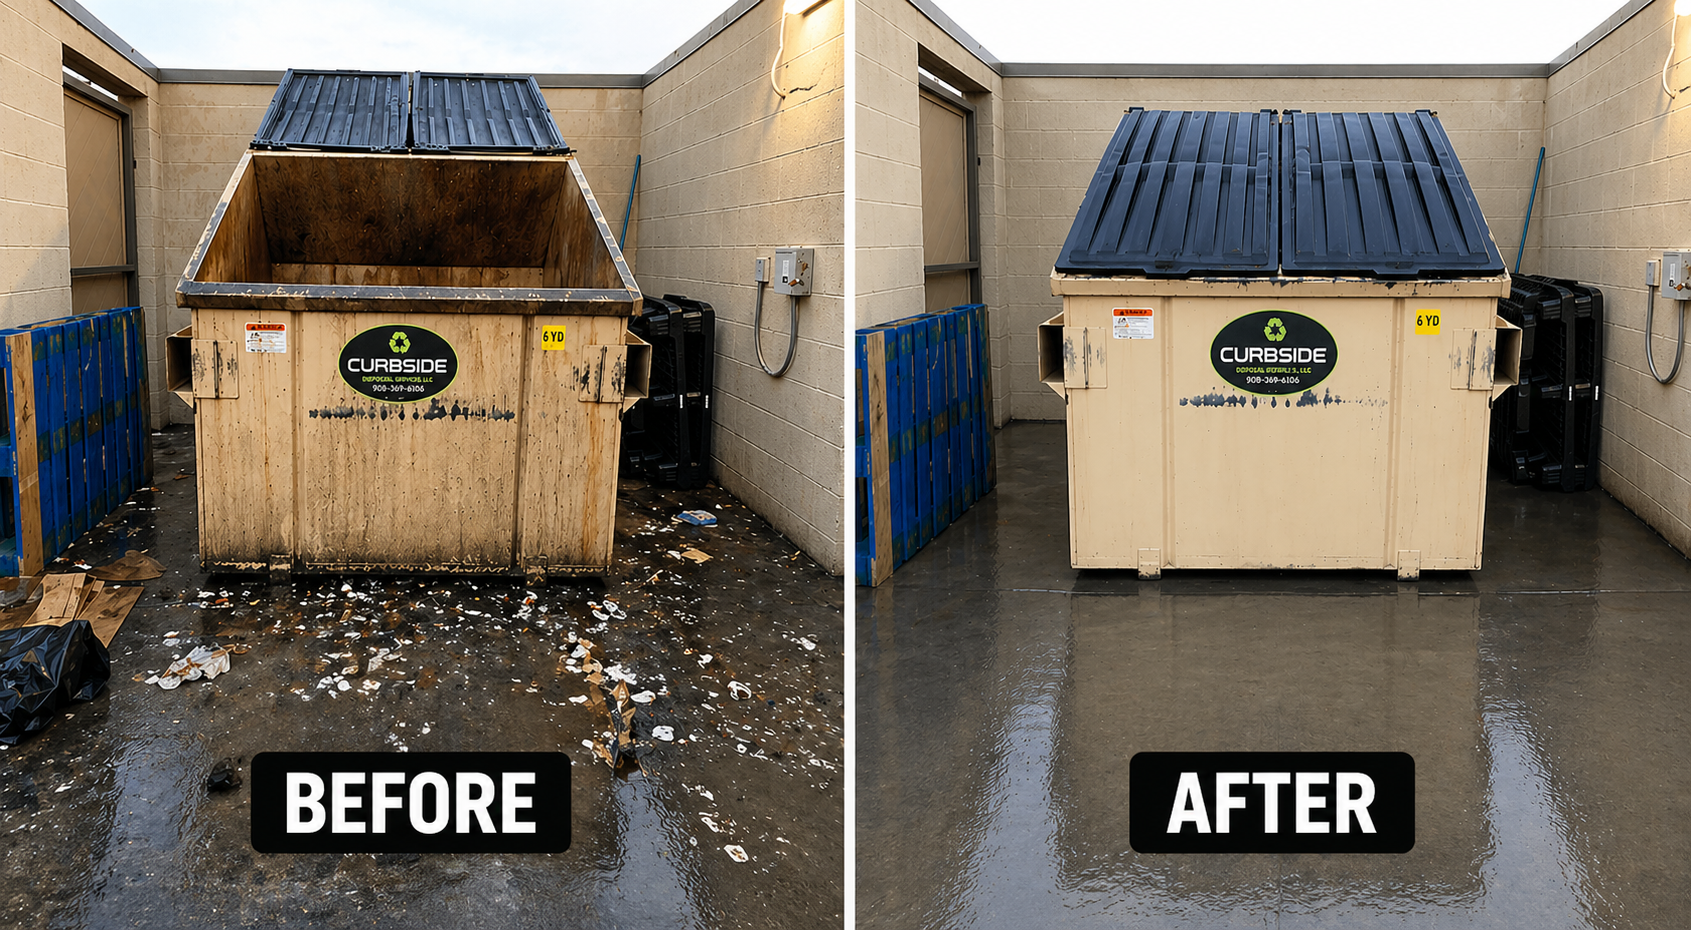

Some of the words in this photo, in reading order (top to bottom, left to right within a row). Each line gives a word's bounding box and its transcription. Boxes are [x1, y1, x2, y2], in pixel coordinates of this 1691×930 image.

[1417, 315, 1423, 326] 6
[1425, 315, 1440, 326] YD
[543, 331, 549, 342] 6
[550, 331, 564, 342] YD
[1220, 347, 1327, 363] CURBSIDE
[348, 358, 447, 373] CURBSIDE
